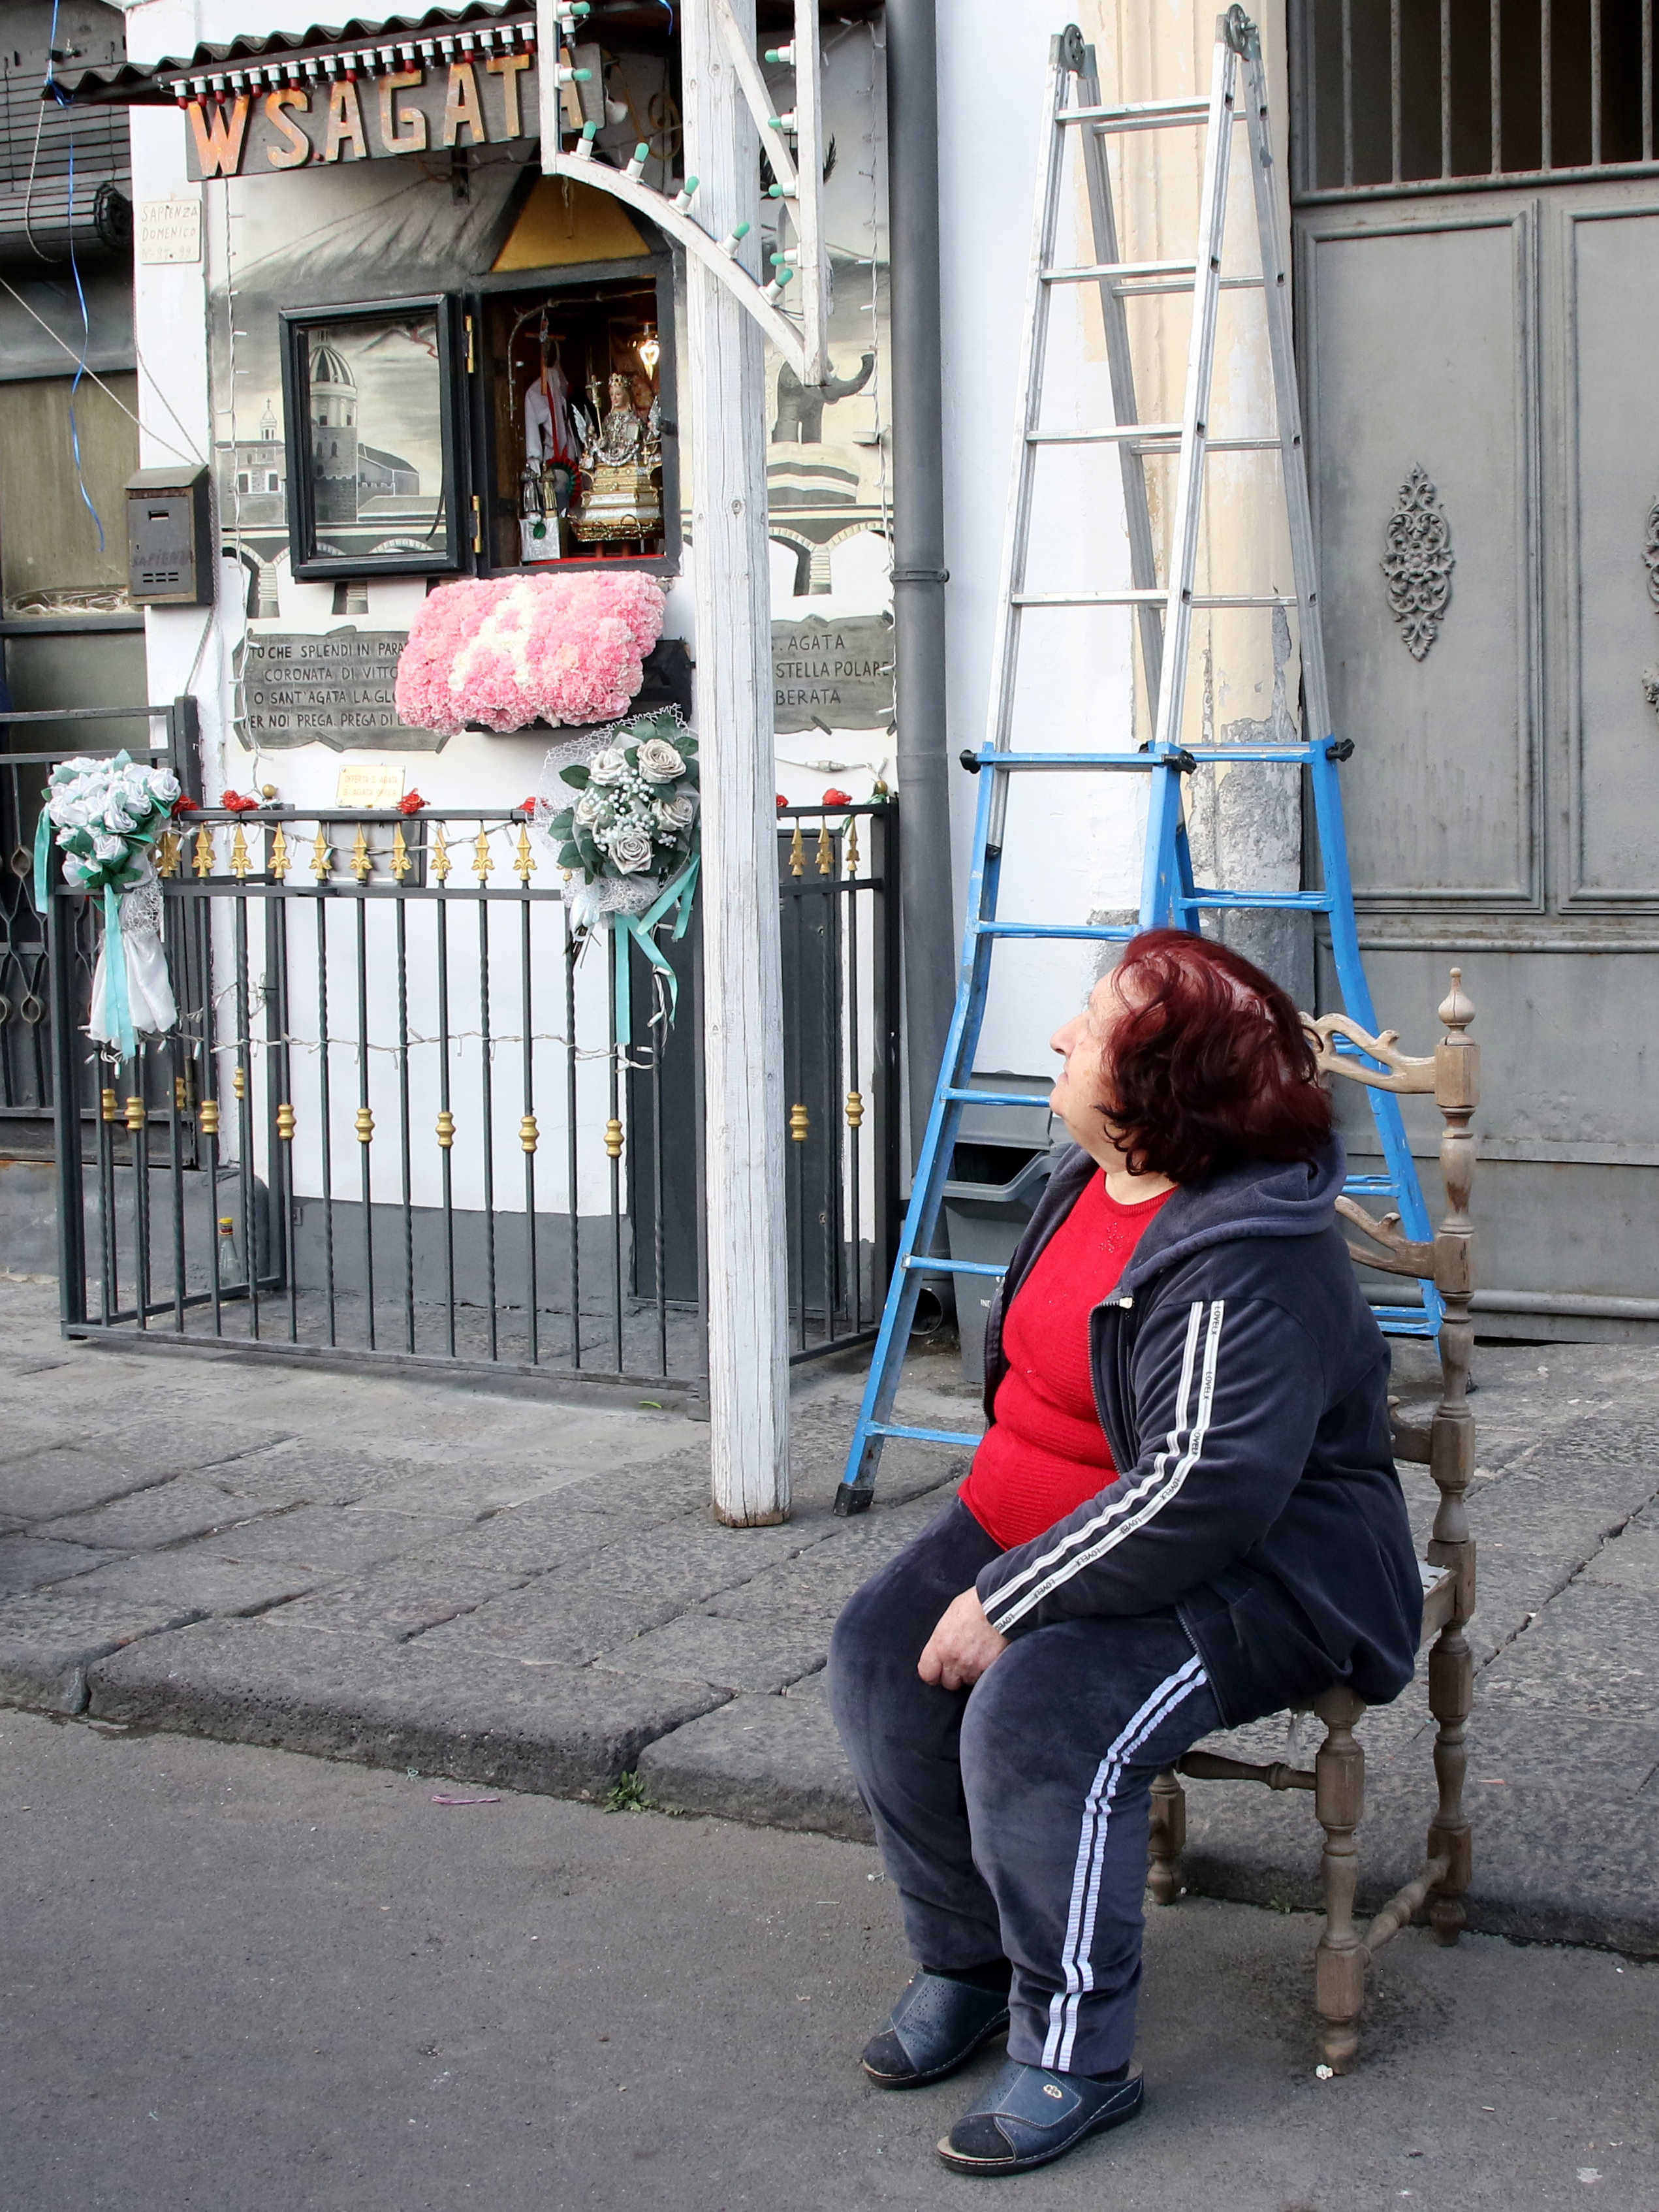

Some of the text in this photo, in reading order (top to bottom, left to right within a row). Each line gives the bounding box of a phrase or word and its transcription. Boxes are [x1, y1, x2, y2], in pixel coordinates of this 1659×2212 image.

[141, 205, 198, 223] SAPIENZA
[142, 226, 197, 242] DOMENICO
[787, 633, 845, 651] AGATA
[268, 646, 292, 659] CHE
[300, 643, 352, 658] SPLENDI
[358, 644, 370, 656] IN
[264, 667, 333, 682] CORONATA
[341, 667, 355, 680] DI
[775, 661, 889, 678] STELLA POLARE
[254, 691, 264, 704] O
[270, 689, 347, 705] SANT'AGATA
[354, 690, 371, 704] LA
[268, 714, 290, 729] NOI
[341, 712, 376, 727] PREGA
[381, 713, 393, 726] DI
